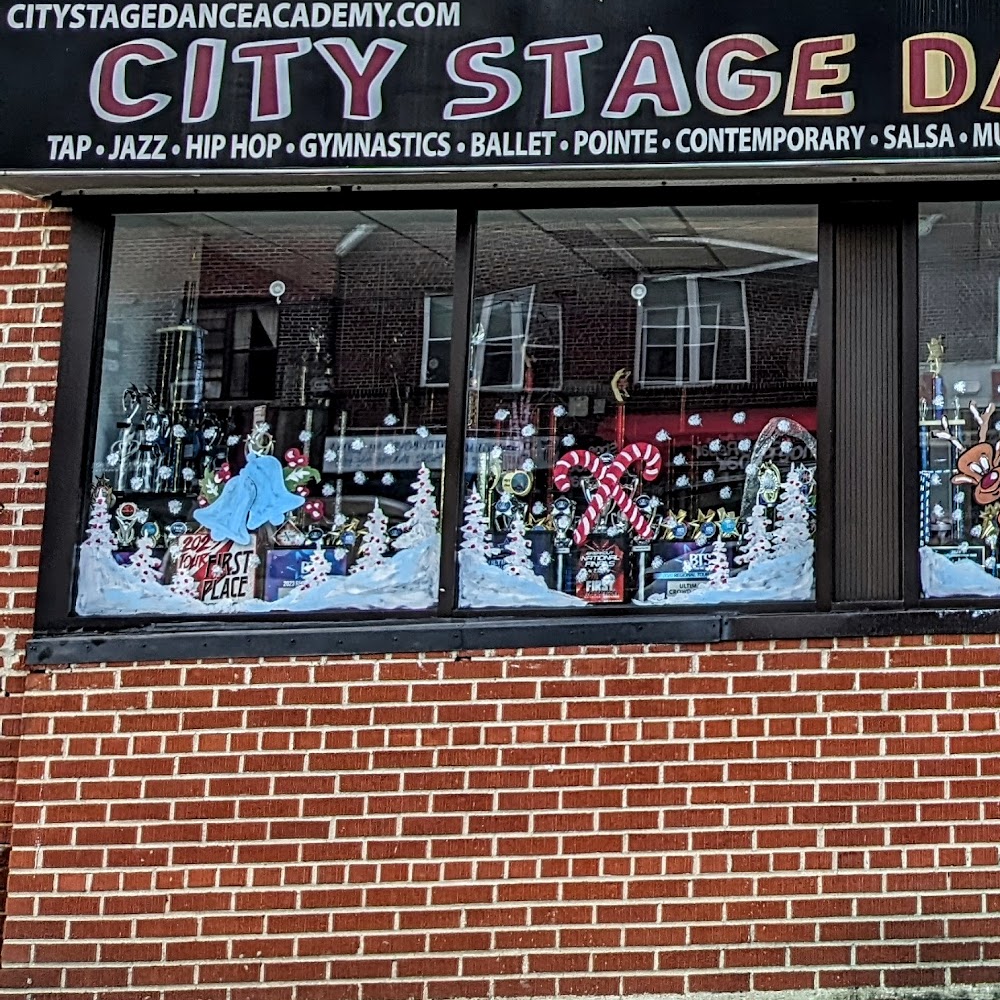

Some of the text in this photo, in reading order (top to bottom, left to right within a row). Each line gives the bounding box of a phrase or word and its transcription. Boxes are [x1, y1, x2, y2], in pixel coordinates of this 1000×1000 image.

[6, 1, 460, 29] CITYSTAGEDANCEACADEMY.COM
[88, 35, 407, 124] CITY
[443, 31, 856, 120] STAGE
[47, 135, 92, 161] TAP
[108, 134, 168, 161] JAZZ
[185, 134, 227, 160] HIP
[230, 133, 282, 159] HOP
[299, 131, 451, 158] GYMNASTICS
[470, 130, 557, 158] BALLET
[573, 129, 658, 156] POINTE
[675, 125, 866, 154] CONTEMPORARY
[883, 123, 955, 150] SALSA
[206, 550, 254, 577] FIRST
[689, 553, 712, 566] BTS
[201, 576, 248, 602] PLACE
